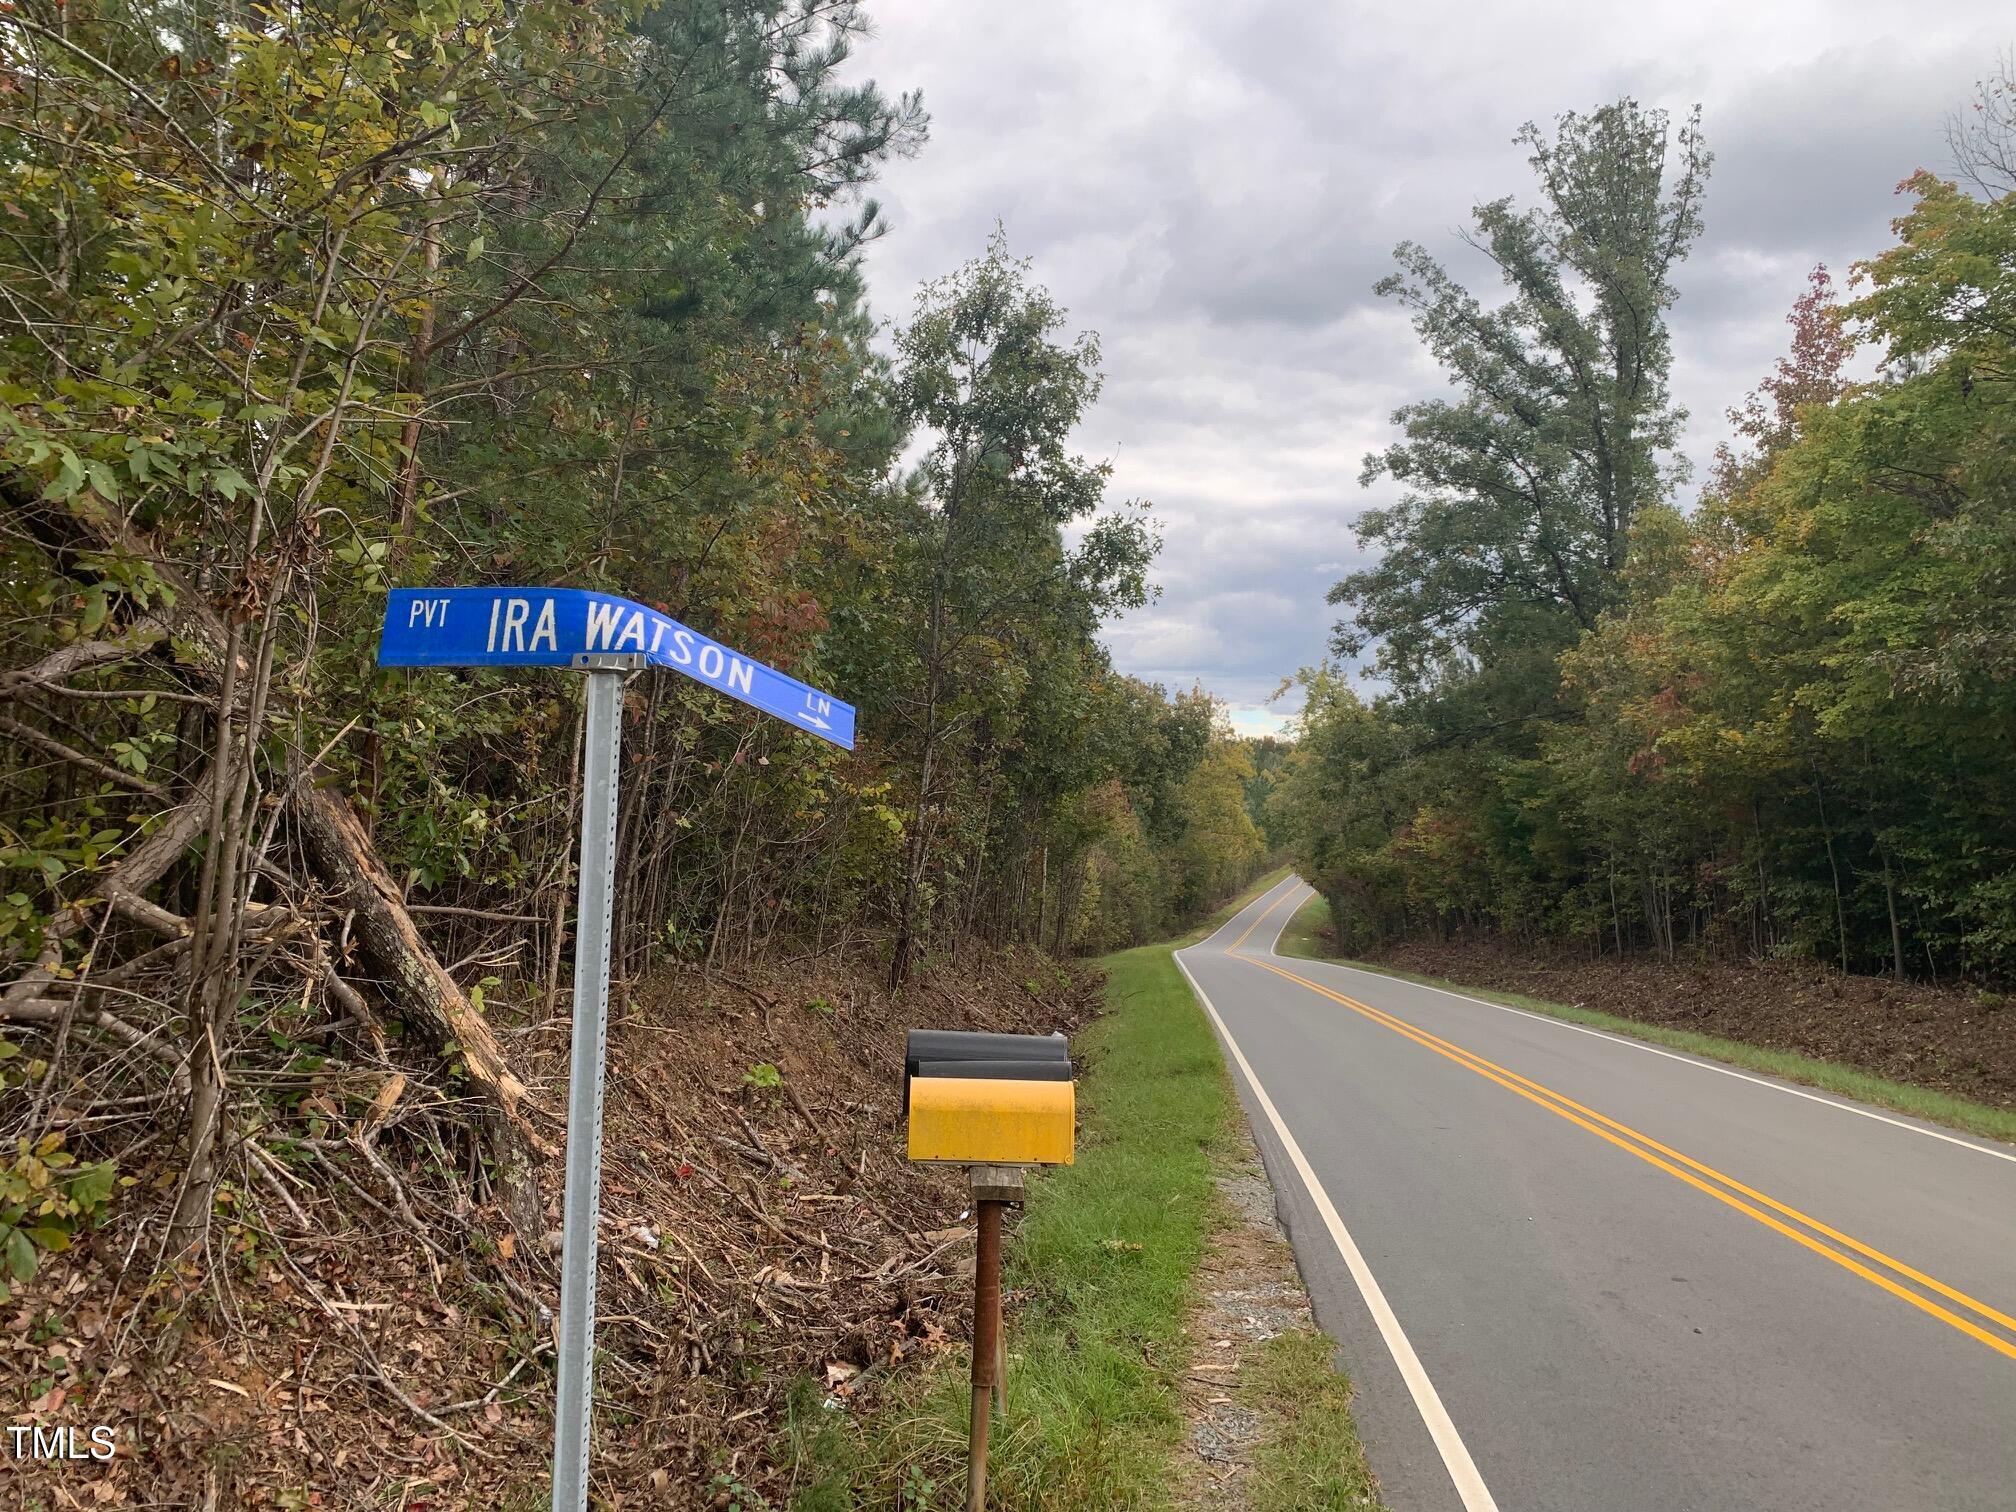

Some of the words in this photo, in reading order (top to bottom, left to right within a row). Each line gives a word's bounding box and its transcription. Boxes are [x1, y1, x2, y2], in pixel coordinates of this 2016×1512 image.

[409, 599, 451, 628] PVT
[487, 598, 558, 653] IRA
[585, 601, 754, 695] WATSON
[805, 691, 831, 717] LN
